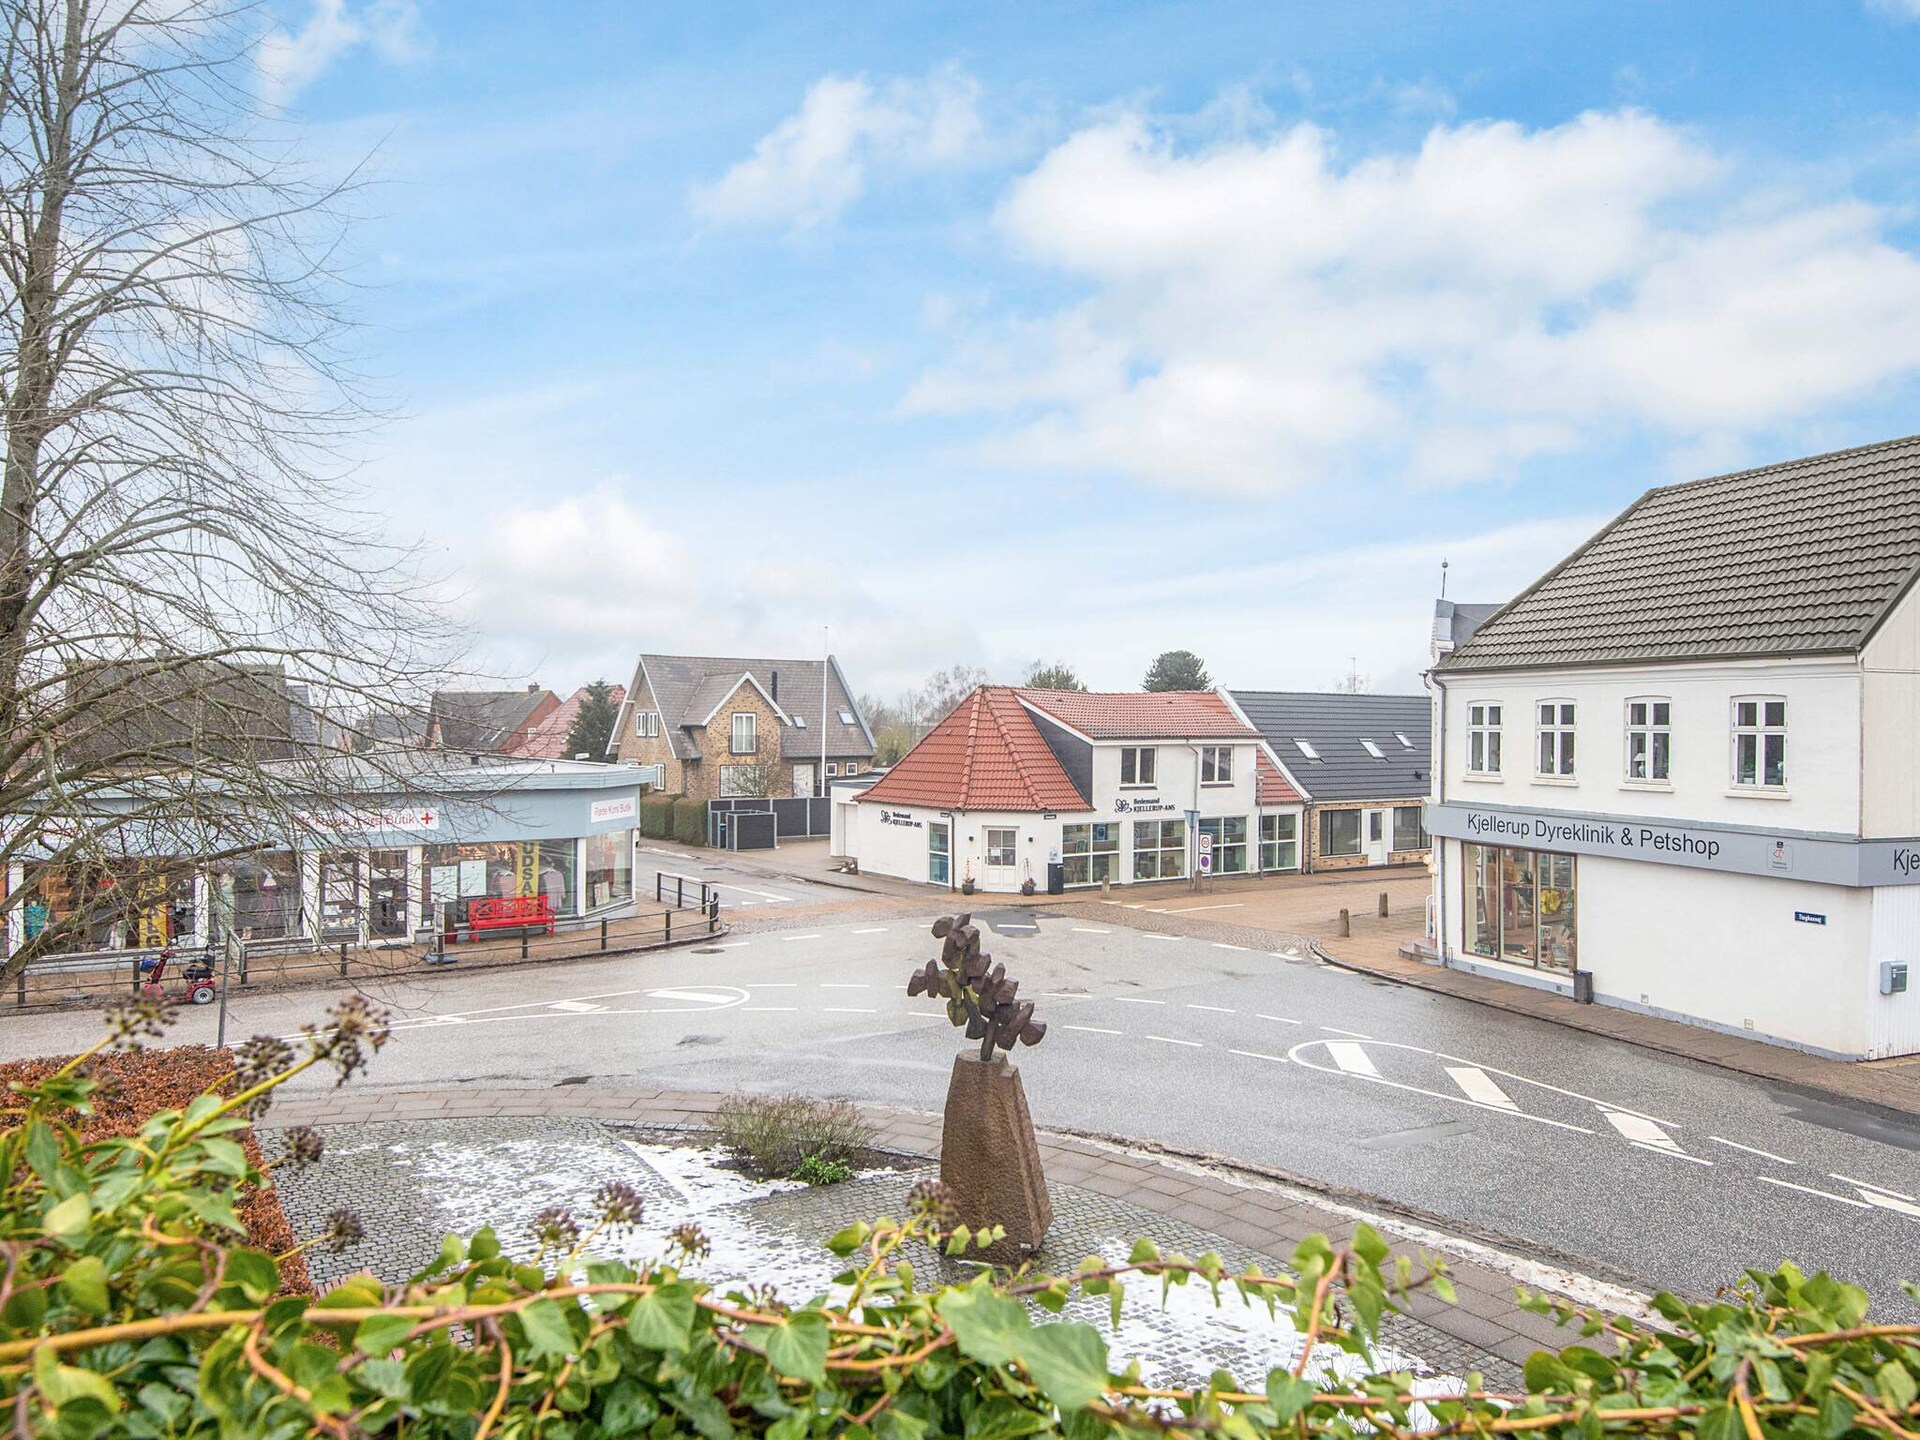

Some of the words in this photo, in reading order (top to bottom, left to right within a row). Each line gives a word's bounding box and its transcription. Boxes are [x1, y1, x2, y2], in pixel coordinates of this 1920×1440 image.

[1133, 797, 1160, 805] Bedemand
[385, 813, 416, 825] Butik
[1467, 813, 1530, 839] Kjellerup
[1535, 819, 1615, 843] Dyreklinik
[1620, 827, 1634, 847] &
[1640, 829, 1720, 860] Petshop
[521, 841, 536, 896] UDSA
